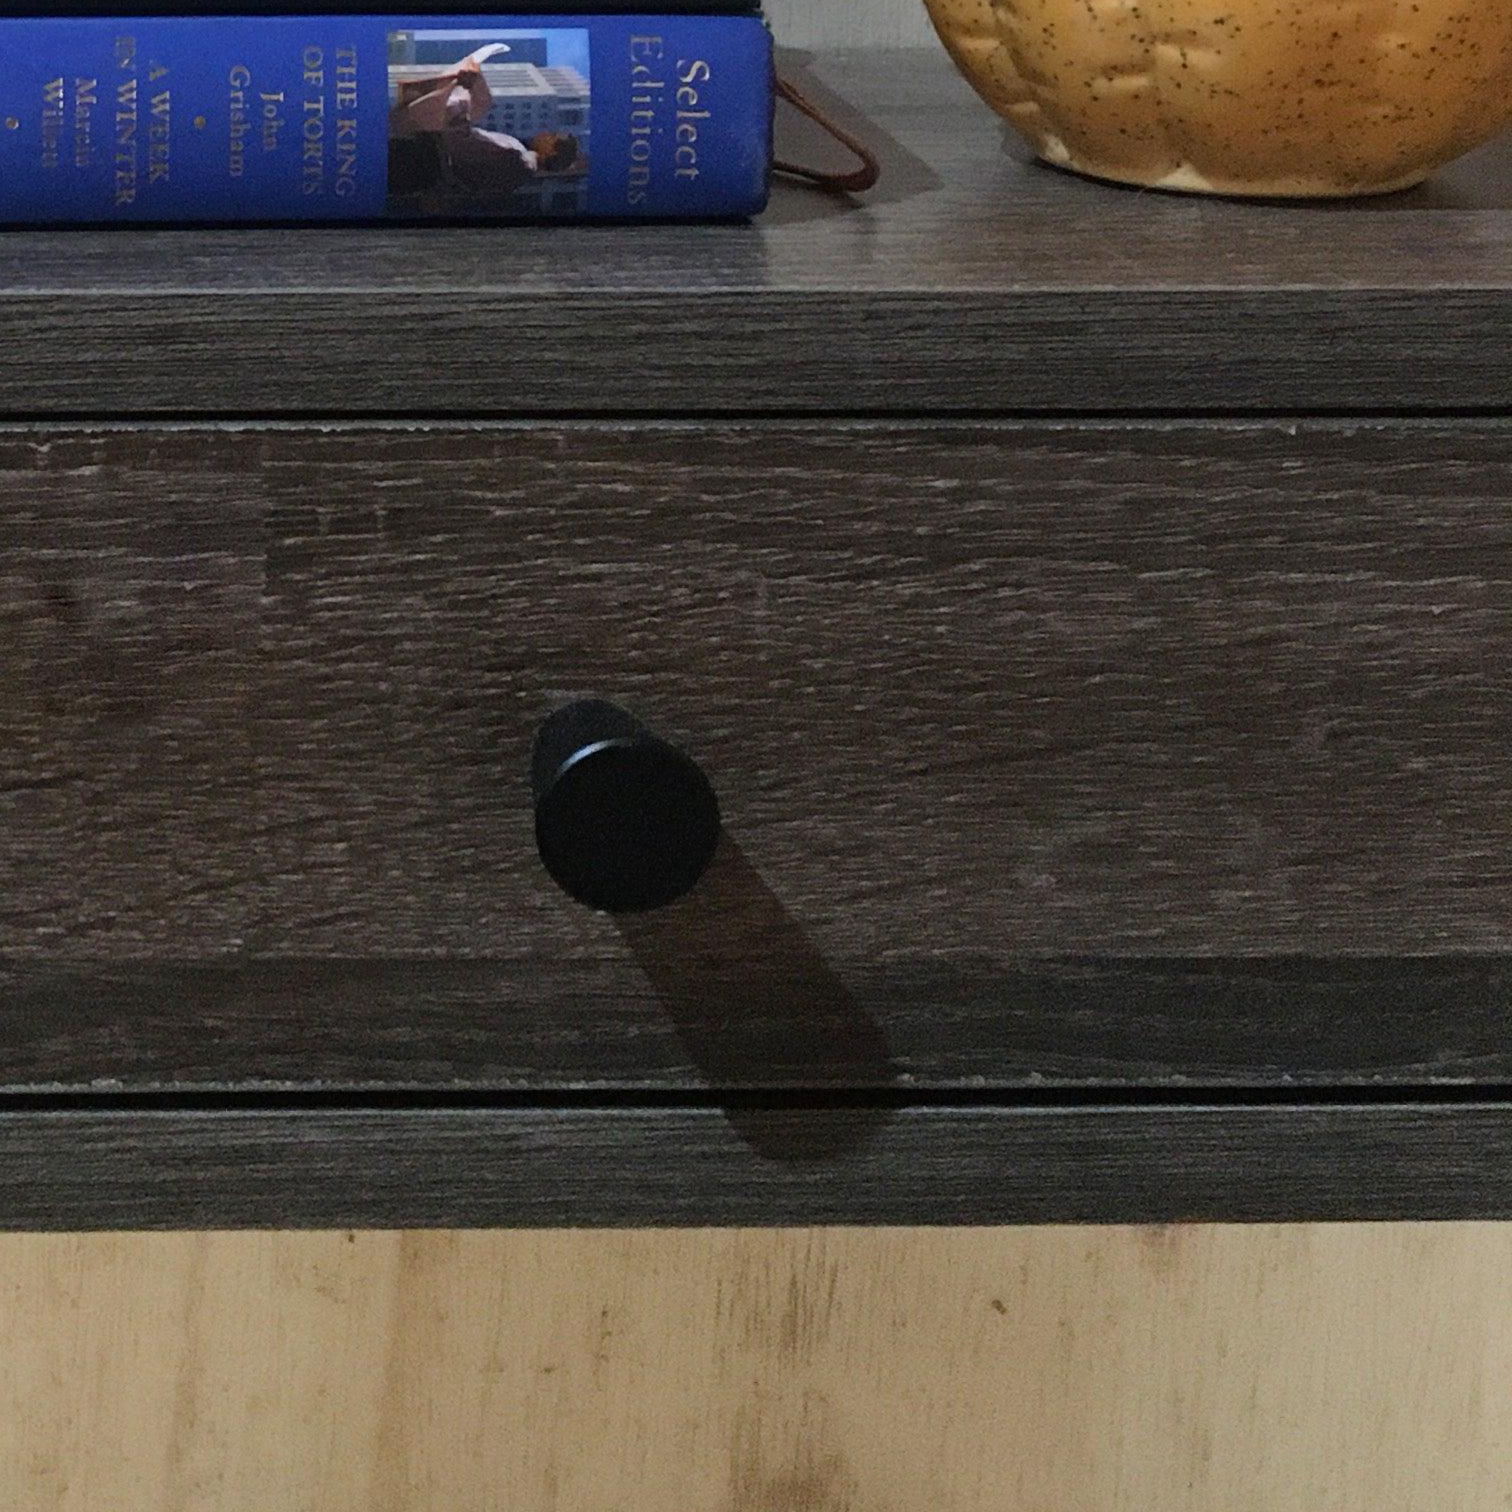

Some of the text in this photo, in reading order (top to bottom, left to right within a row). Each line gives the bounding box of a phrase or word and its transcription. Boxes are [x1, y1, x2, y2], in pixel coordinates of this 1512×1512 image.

[115, 79, 137, 206] WINTER
[149, 60, 170, 184] A WEEK
[229, 65, 251, 177] Grisham
[259, 92, 285, 151] John
[303, 46, 324, 195] OF TORTS
[336, 47, 357, 196] THE KING
[628, 34, 665, 204] Editions
[674, 59, 711, 180] Select
